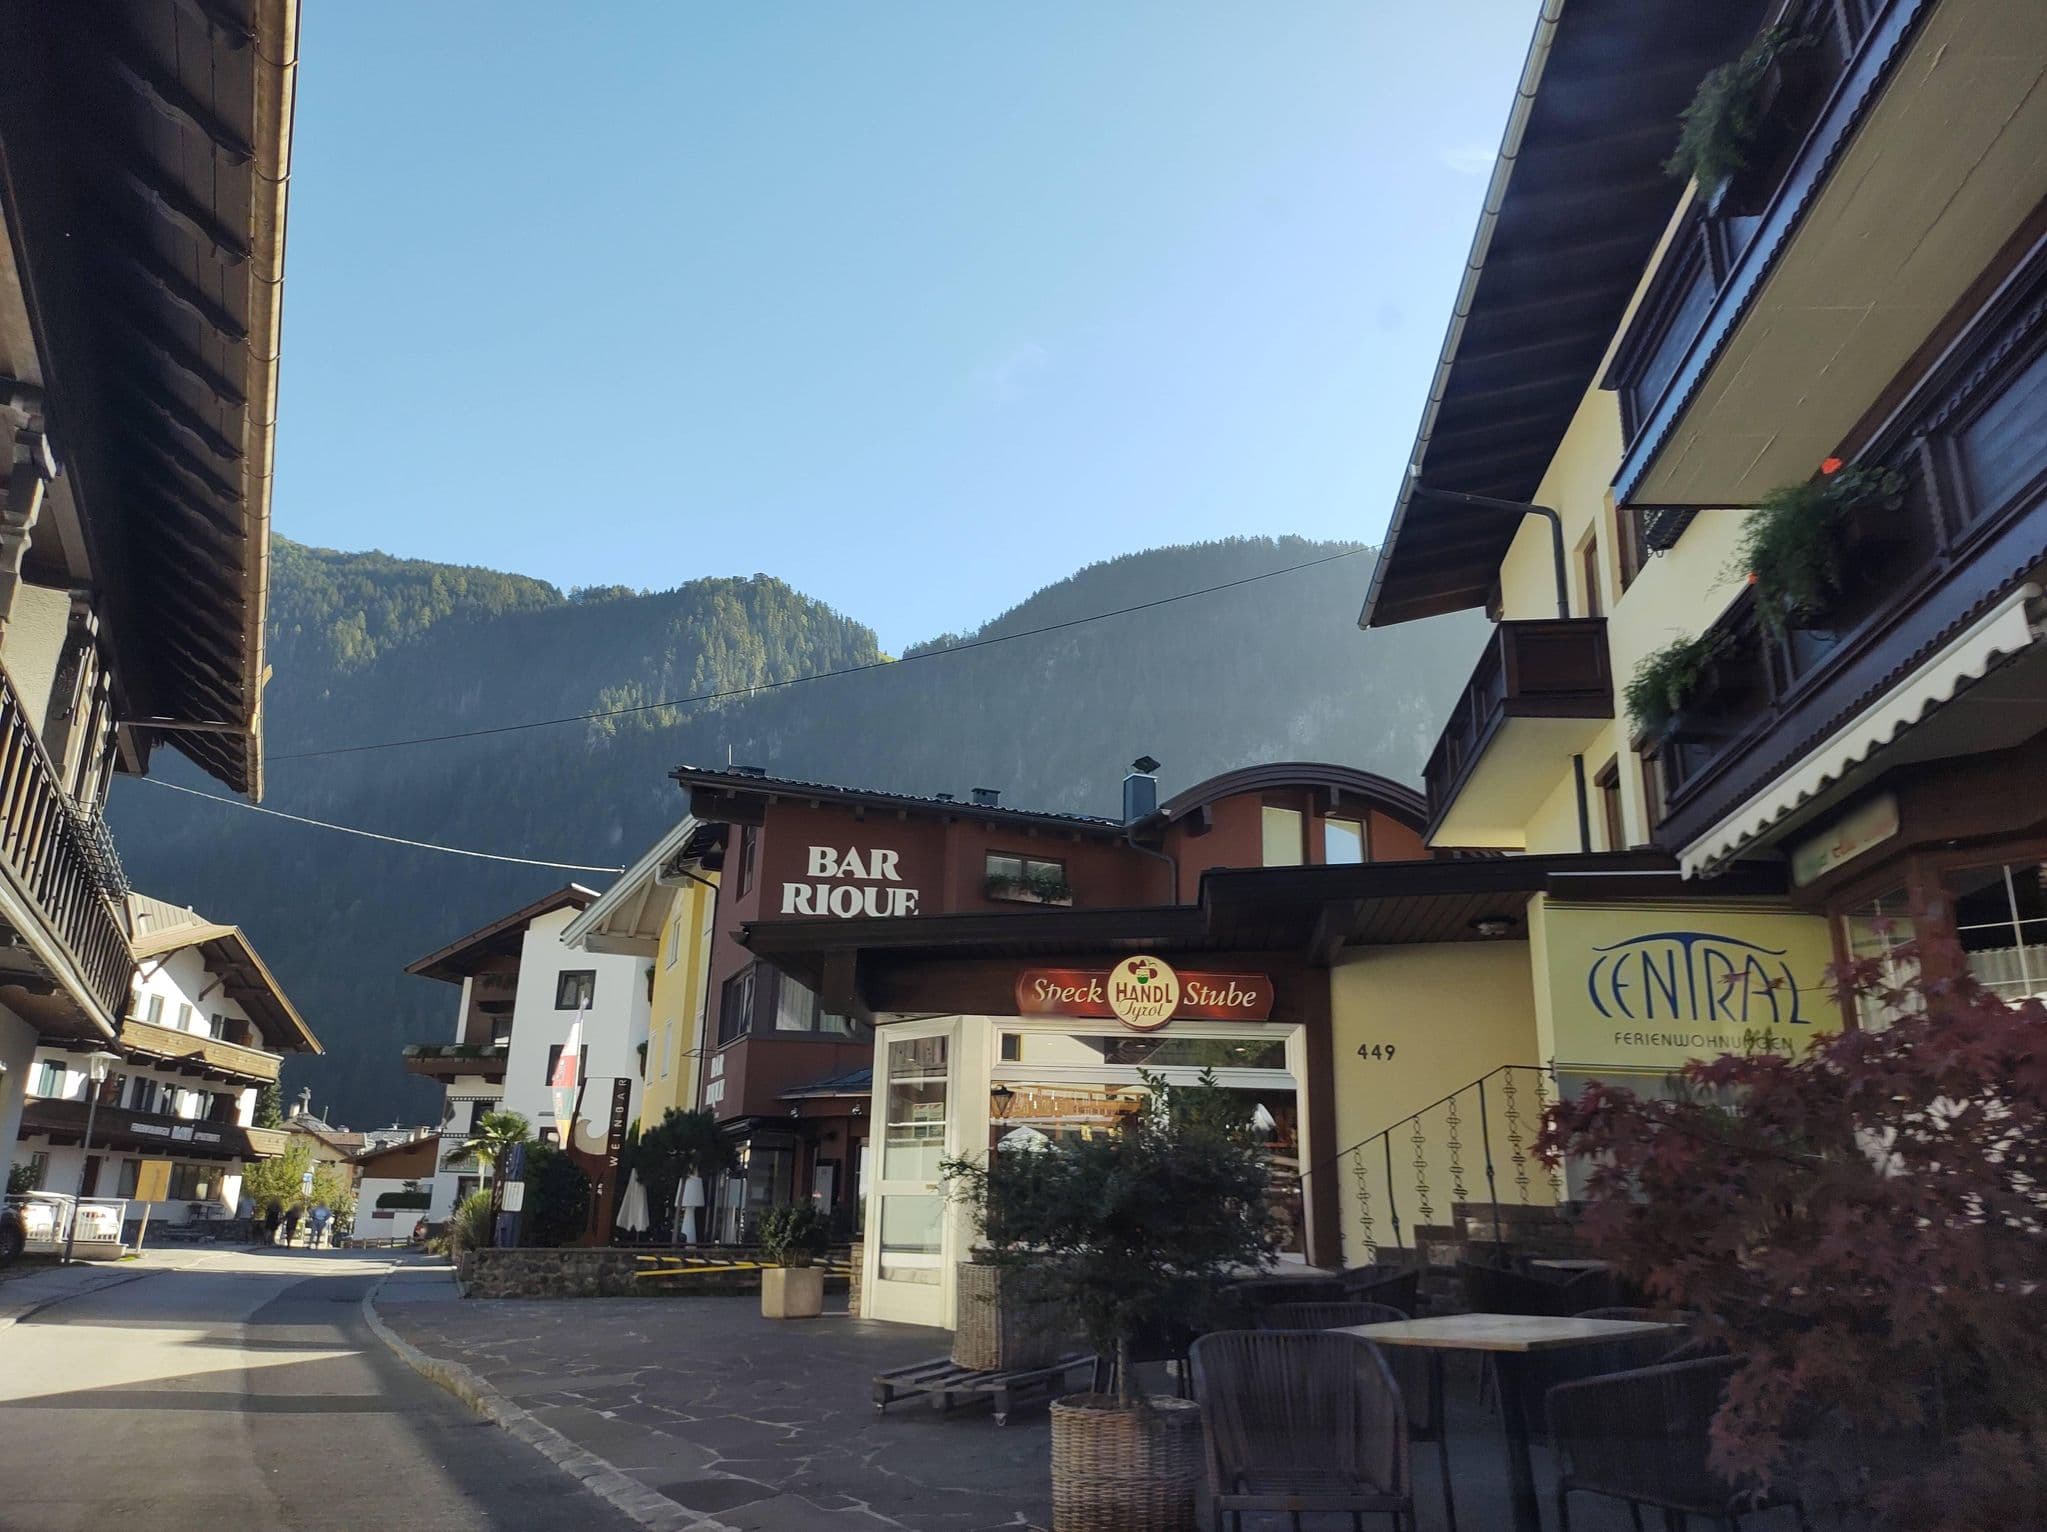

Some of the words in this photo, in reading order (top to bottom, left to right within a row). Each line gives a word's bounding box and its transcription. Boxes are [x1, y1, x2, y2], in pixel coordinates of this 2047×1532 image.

[807, 846, 902, 880] BAR
[781, 883, 919, 918] RIQUE
[1032, 978, 1105, 1004] Speck
[1183, 982, 1257, 1007] Stube
[1116, 981, 1173, 1004] HANDL
[1588, 932, 1811, 1023] CENTRAL
[1118, 998, 1163, 1022] Tyrol
[1357, 1043, 1396, 1061] 449
[609, 1079, 628, 1167] WEINBAR
